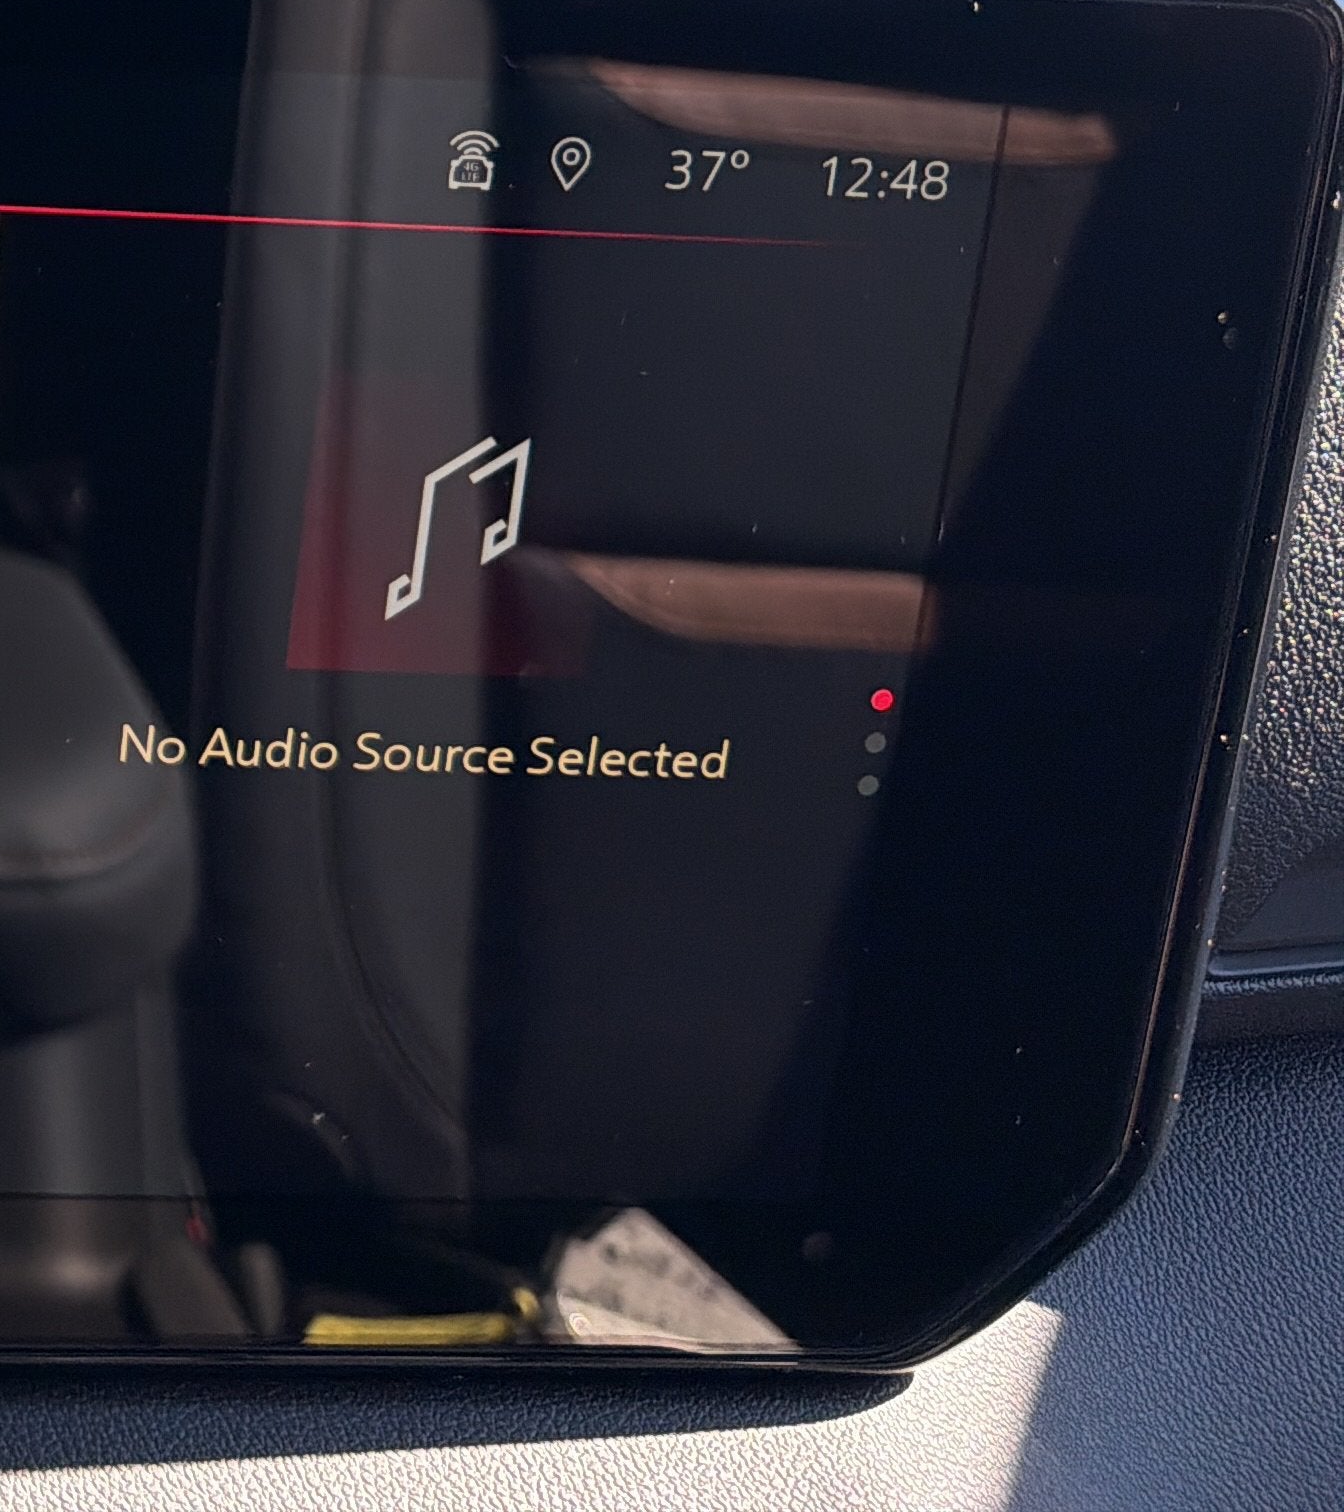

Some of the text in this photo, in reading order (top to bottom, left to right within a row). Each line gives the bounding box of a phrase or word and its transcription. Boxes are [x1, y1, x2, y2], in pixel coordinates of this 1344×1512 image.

[665, 149, 950, 200] 37° 12:48
[119, 723, 730, 779] No Audio Source Selected
